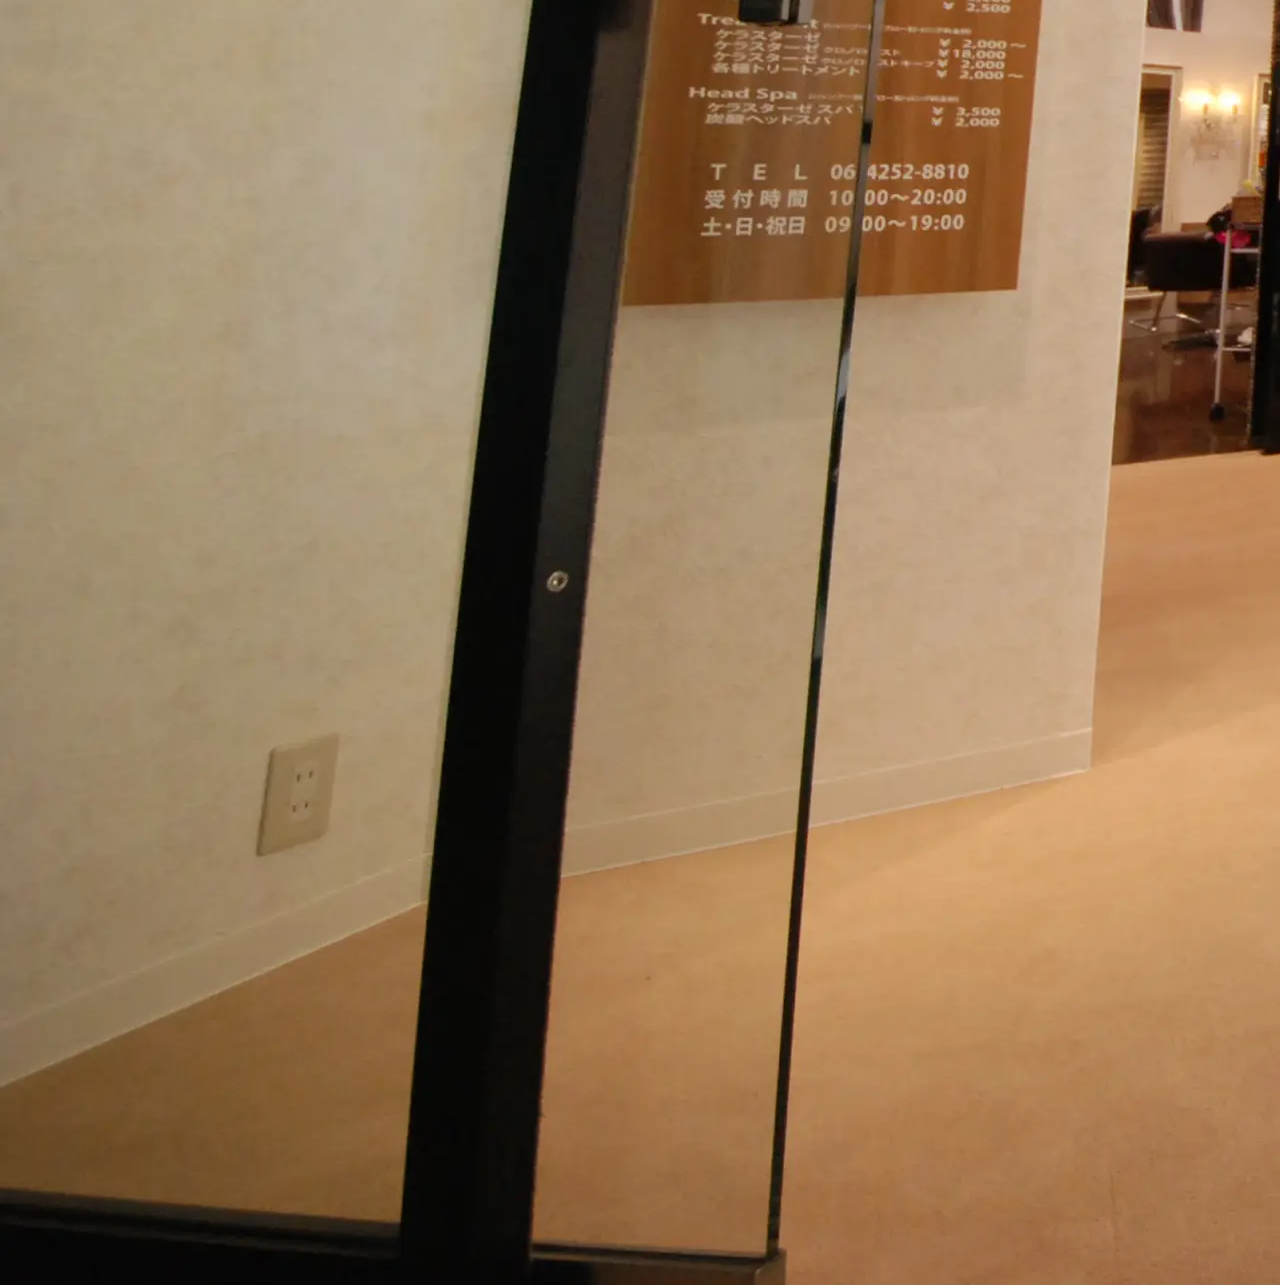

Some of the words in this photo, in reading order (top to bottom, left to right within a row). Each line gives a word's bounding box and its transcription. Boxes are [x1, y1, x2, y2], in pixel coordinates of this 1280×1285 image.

[715, 30, 822, 43] ケラスターゼ
[714, 40, 820, 54] ケラスターゼ
[953, 49, 1007, 60] 18,000
[713, 51, 819, 65] ケラスターゼ
[961, 59, 1005, 70] 2,000
[688, 87, 750, 100] Head
[756, 87, 798, 102] Spa
[955, 117, 1000, 128] 2,000
[830, 163, 970, 181] 064252-8810
[704, 189, 809, 211] 受付時間
[829, 188, 968, 206] 1000〜20:00
[825, 214, 965, 233] 0900〜19:00
